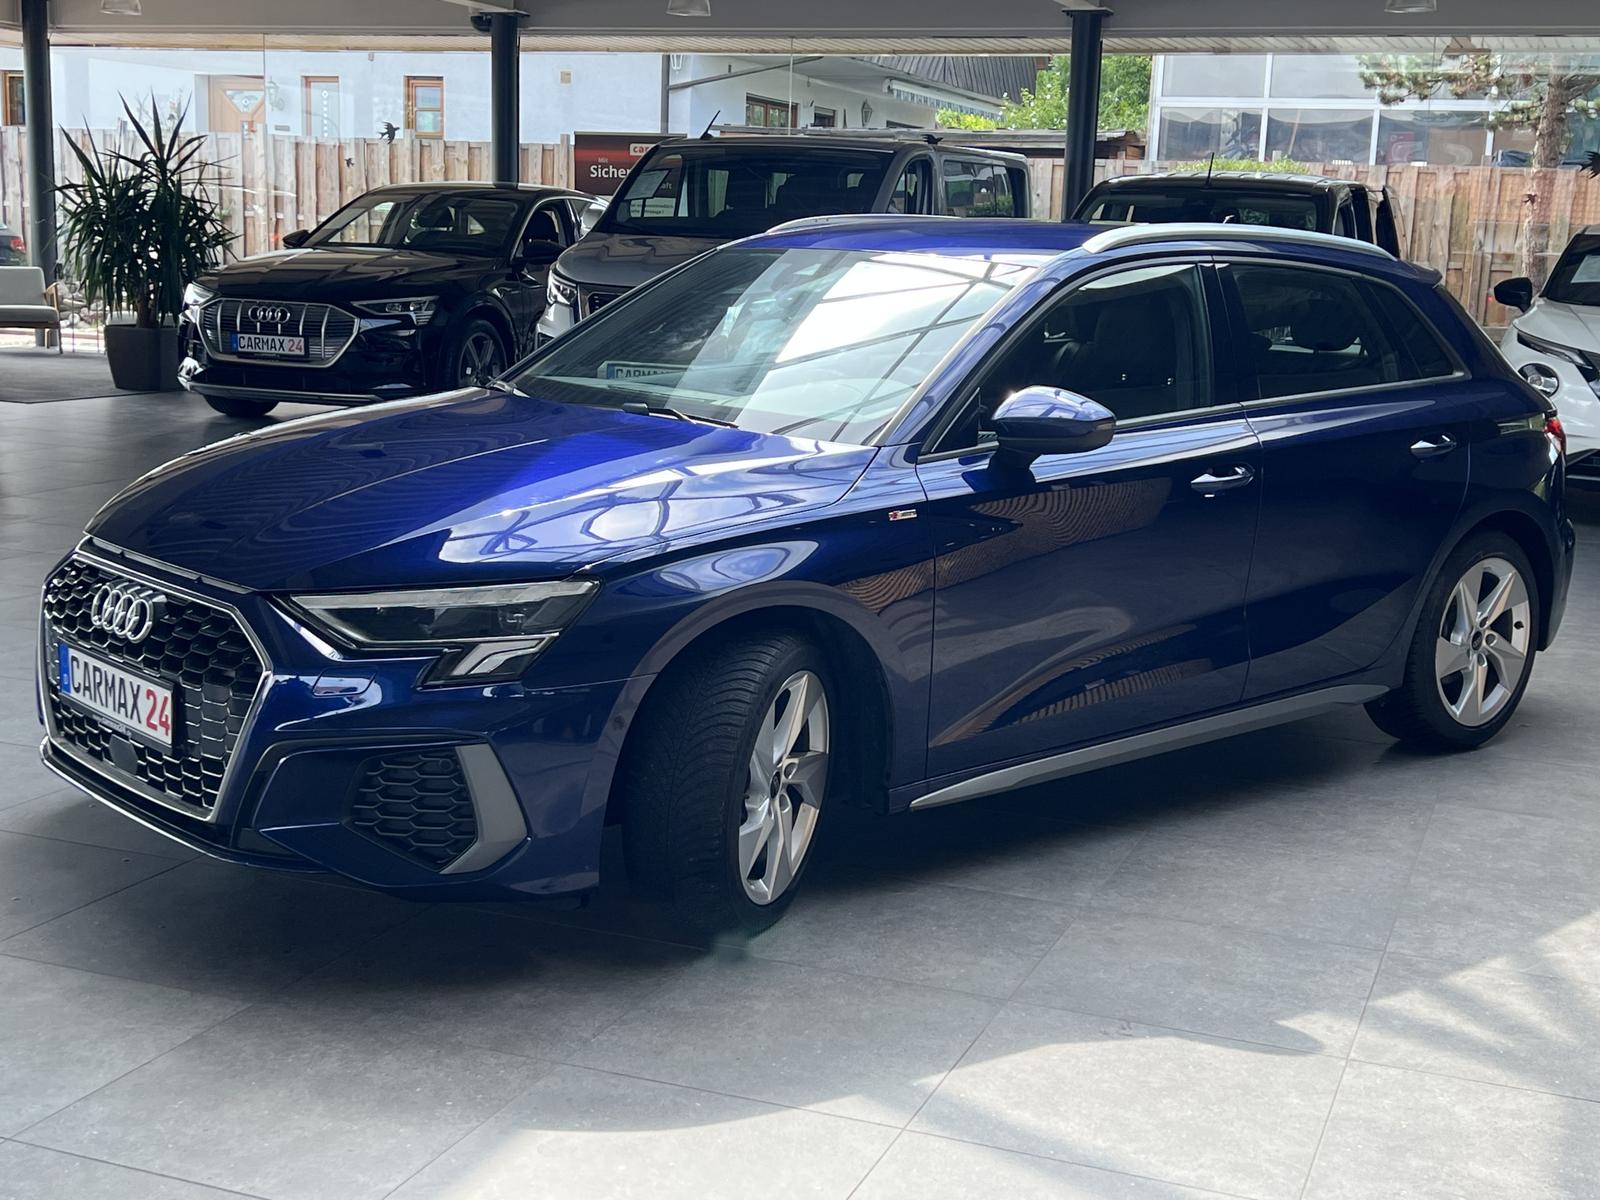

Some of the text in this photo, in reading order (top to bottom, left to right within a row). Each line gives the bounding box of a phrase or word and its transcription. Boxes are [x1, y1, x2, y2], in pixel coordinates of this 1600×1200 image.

[238, 336, 303, 352] CARMAX 24
[70, 655, 170, 737] CARMAX 24
